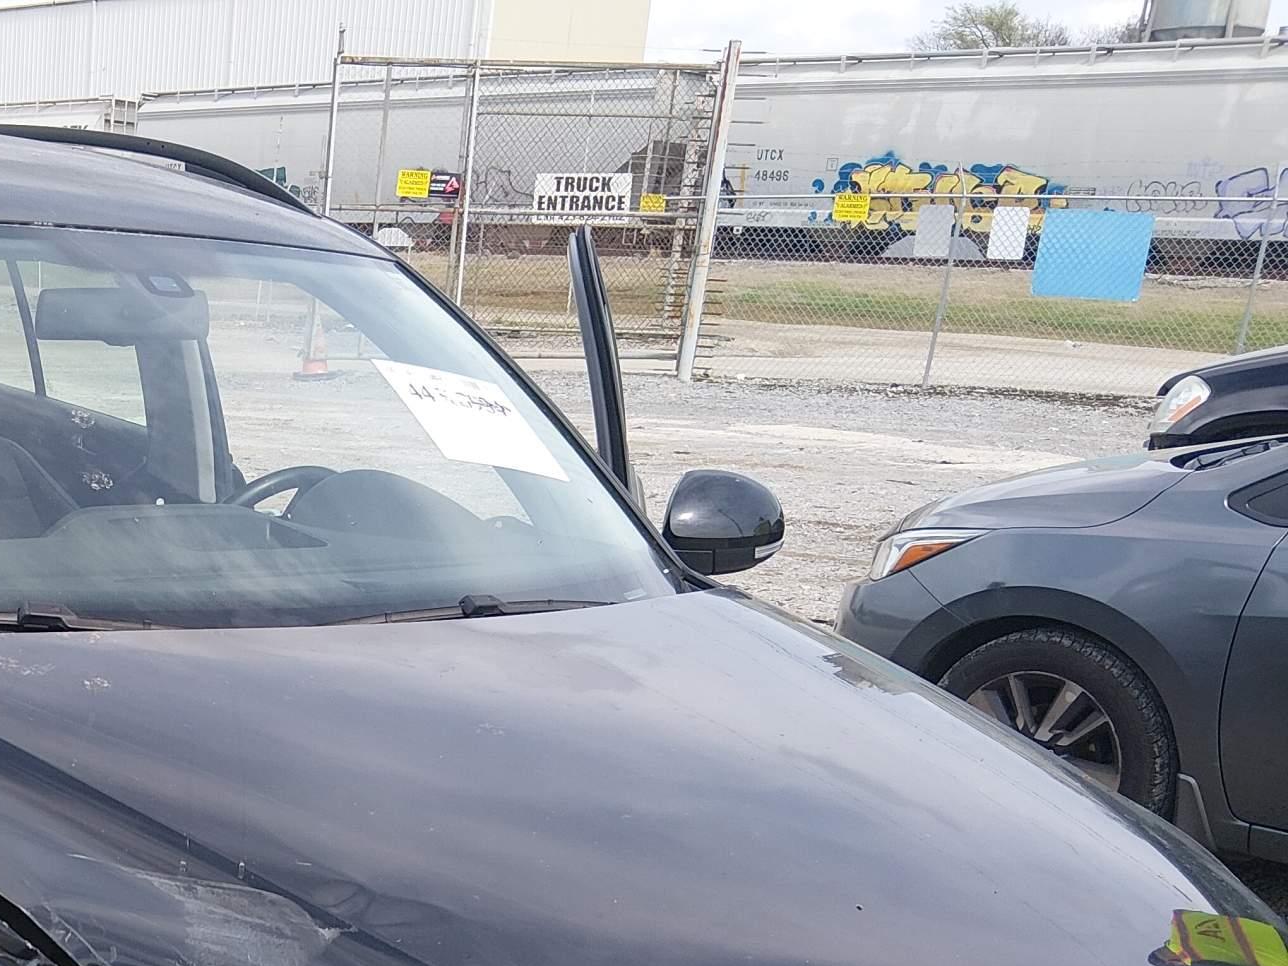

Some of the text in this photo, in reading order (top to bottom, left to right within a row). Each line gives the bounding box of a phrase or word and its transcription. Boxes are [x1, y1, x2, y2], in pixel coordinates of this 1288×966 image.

[756, 149, 784, 161] UTCX
[554, 176, 614, 193] TRUCK
[537, 195, 626, 211] ENTRANCE
